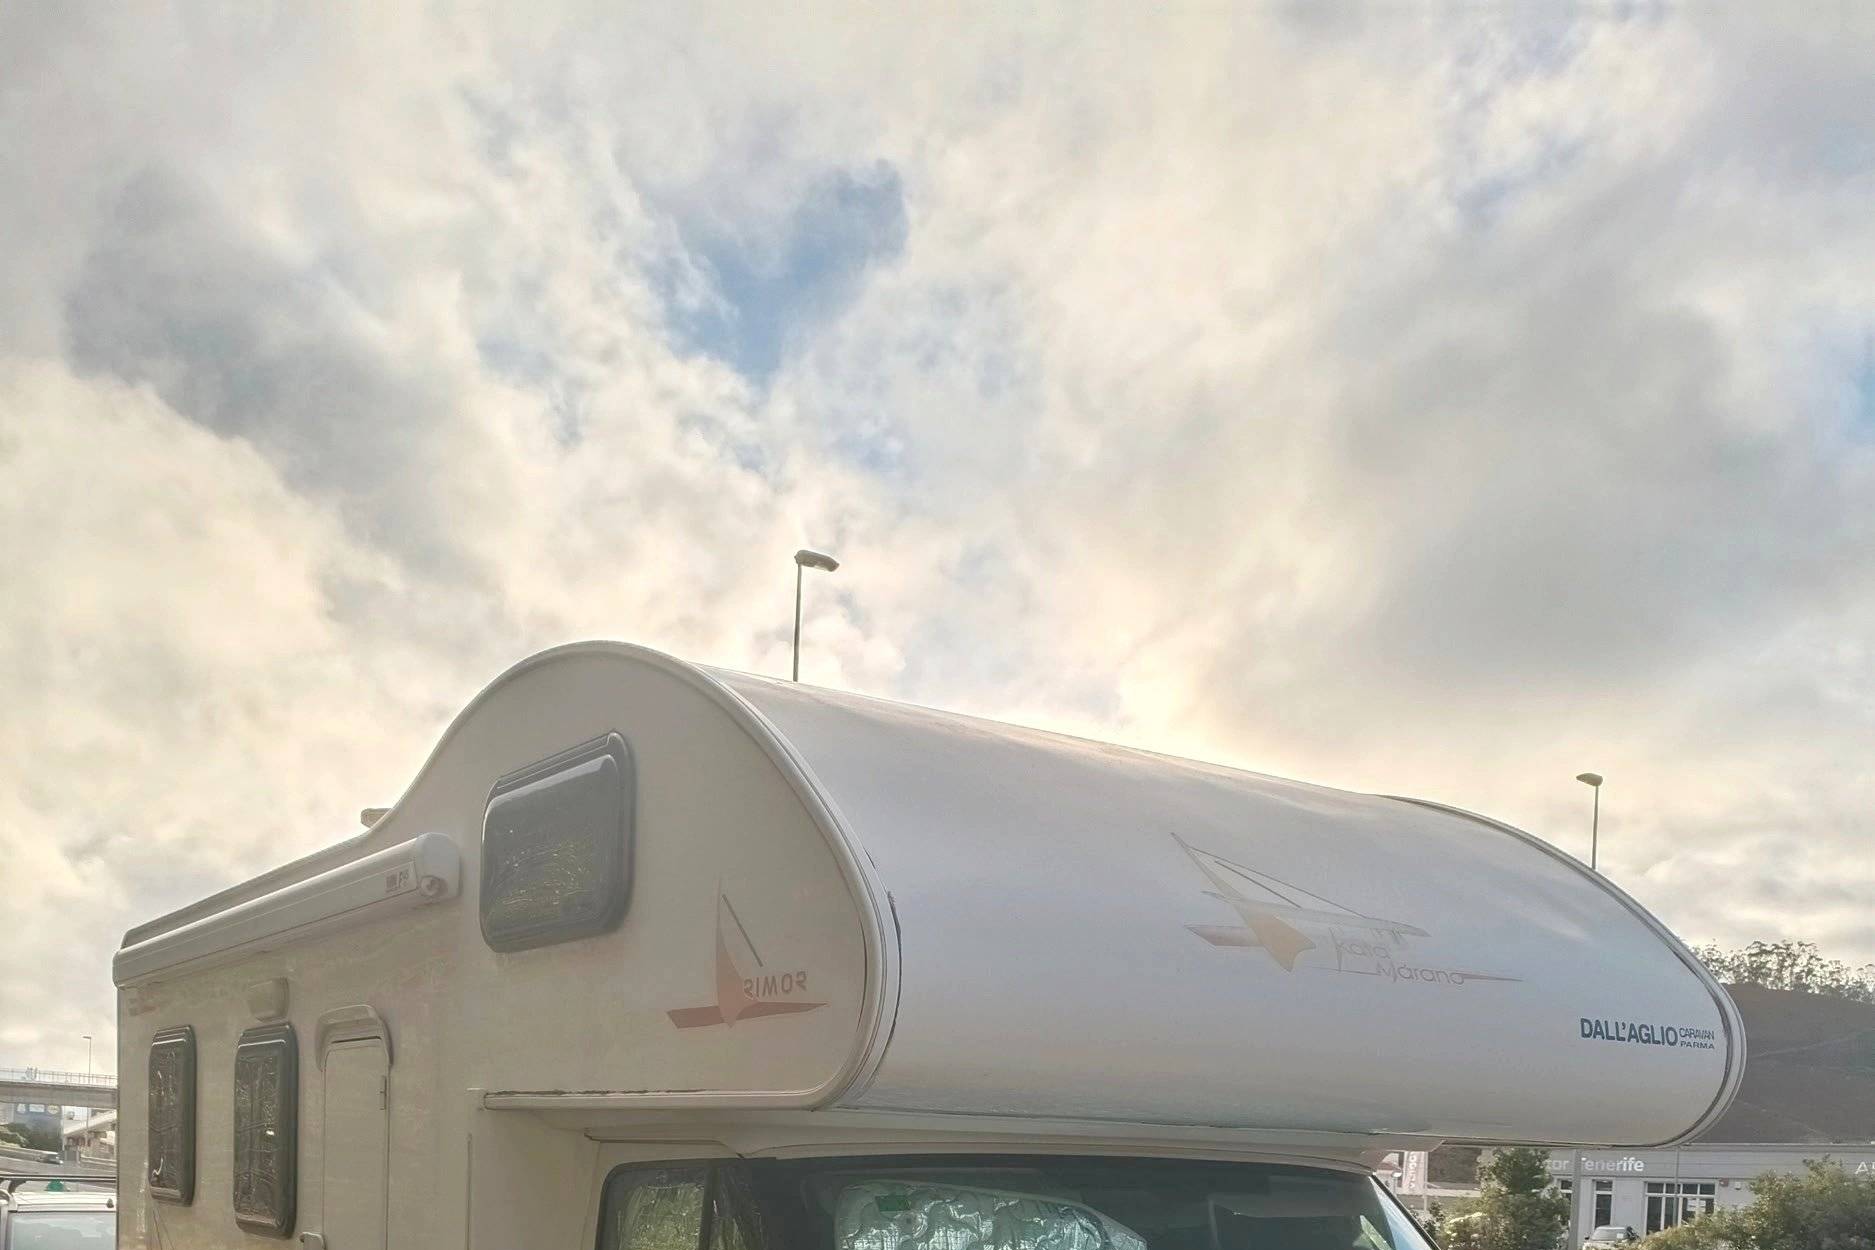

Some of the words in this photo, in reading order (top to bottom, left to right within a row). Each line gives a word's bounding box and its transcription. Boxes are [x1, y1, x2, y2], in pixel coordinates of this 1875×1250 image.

[743, 970, 808, 999] RIMOR
[1580, 1017, 1679, 1047] DALL'AGLIO
[1679, 1027, 1715, 1040] CARAVAN
[1680, 1040, 1715, 1050] PARMA
[1580, 1157, 1644, 1172] Tenerife
